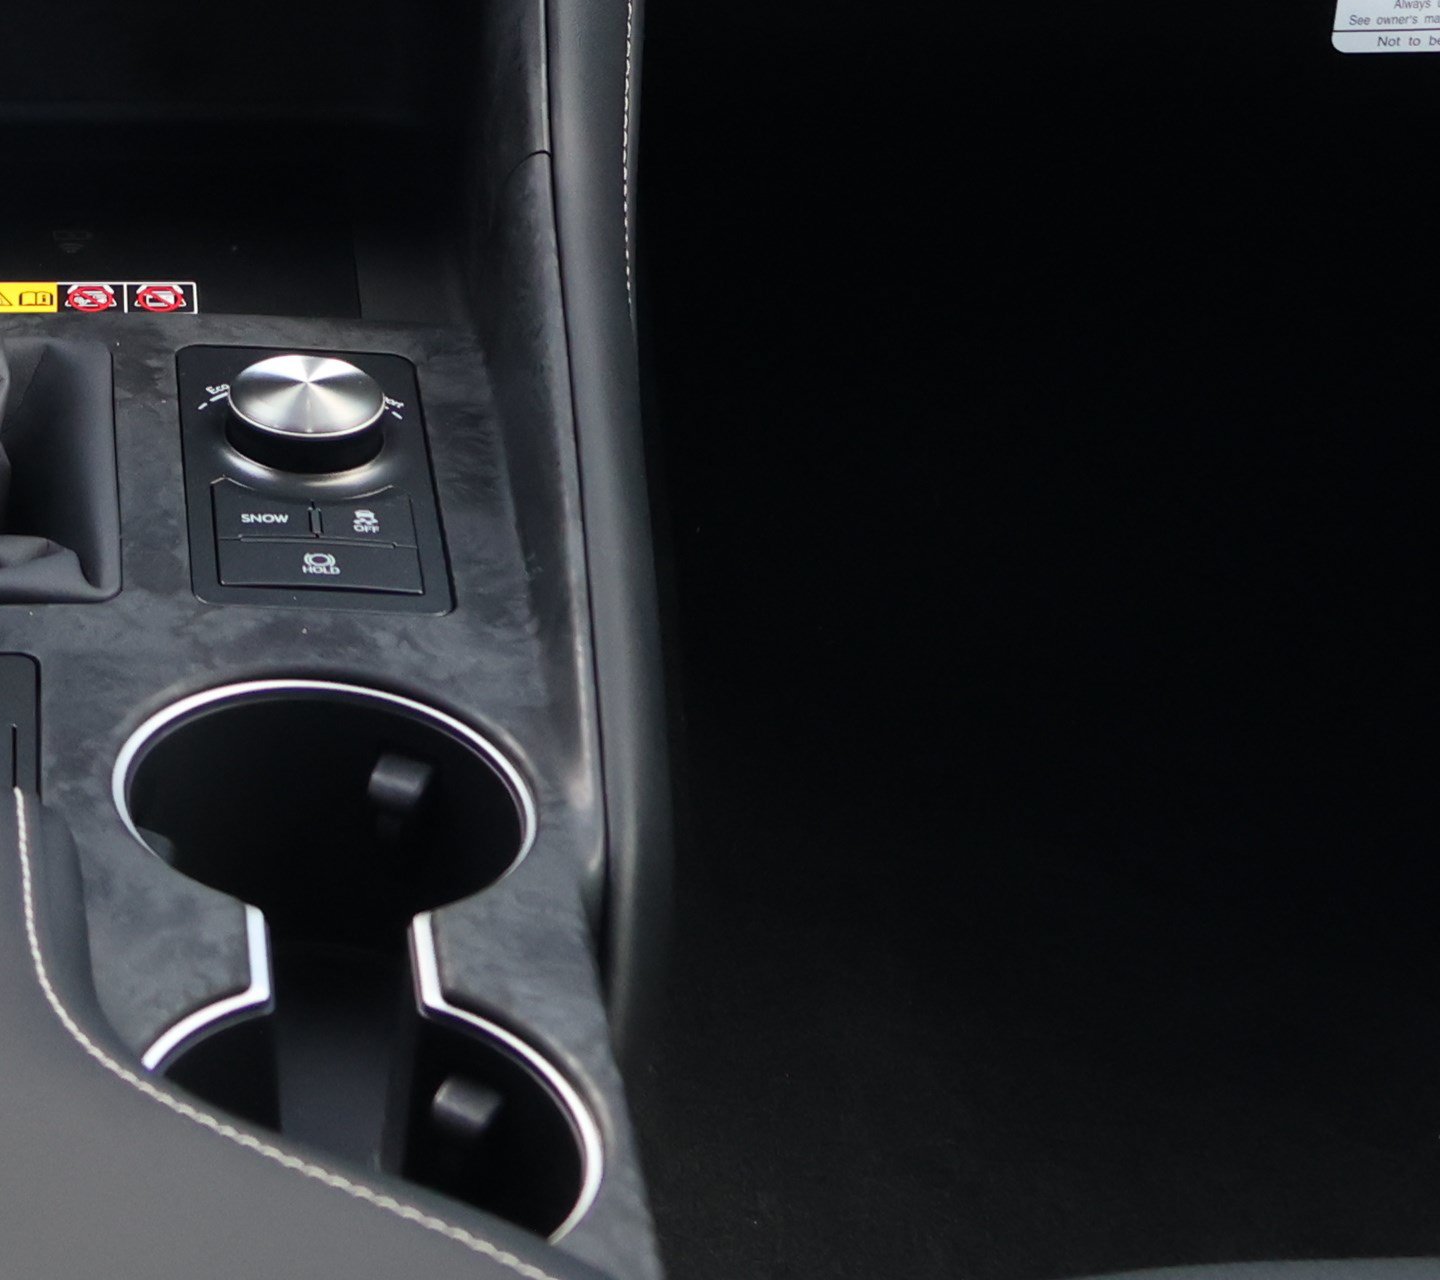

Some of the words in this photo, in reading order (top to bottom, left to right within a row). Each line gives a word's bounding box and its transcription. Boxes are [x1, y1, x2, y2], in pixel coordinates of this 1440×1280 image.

[1349, 15, 1370, 25] See
[1376, 14, 1418, 25] owner's
[1377, 36, 1400, 47] Not
[1408, 37, 1420, 47] to
[241, 513, 289, 524] SNOW
[353, 524, 380, 533] OFF
[302, 565, 342, 576] HOLD
